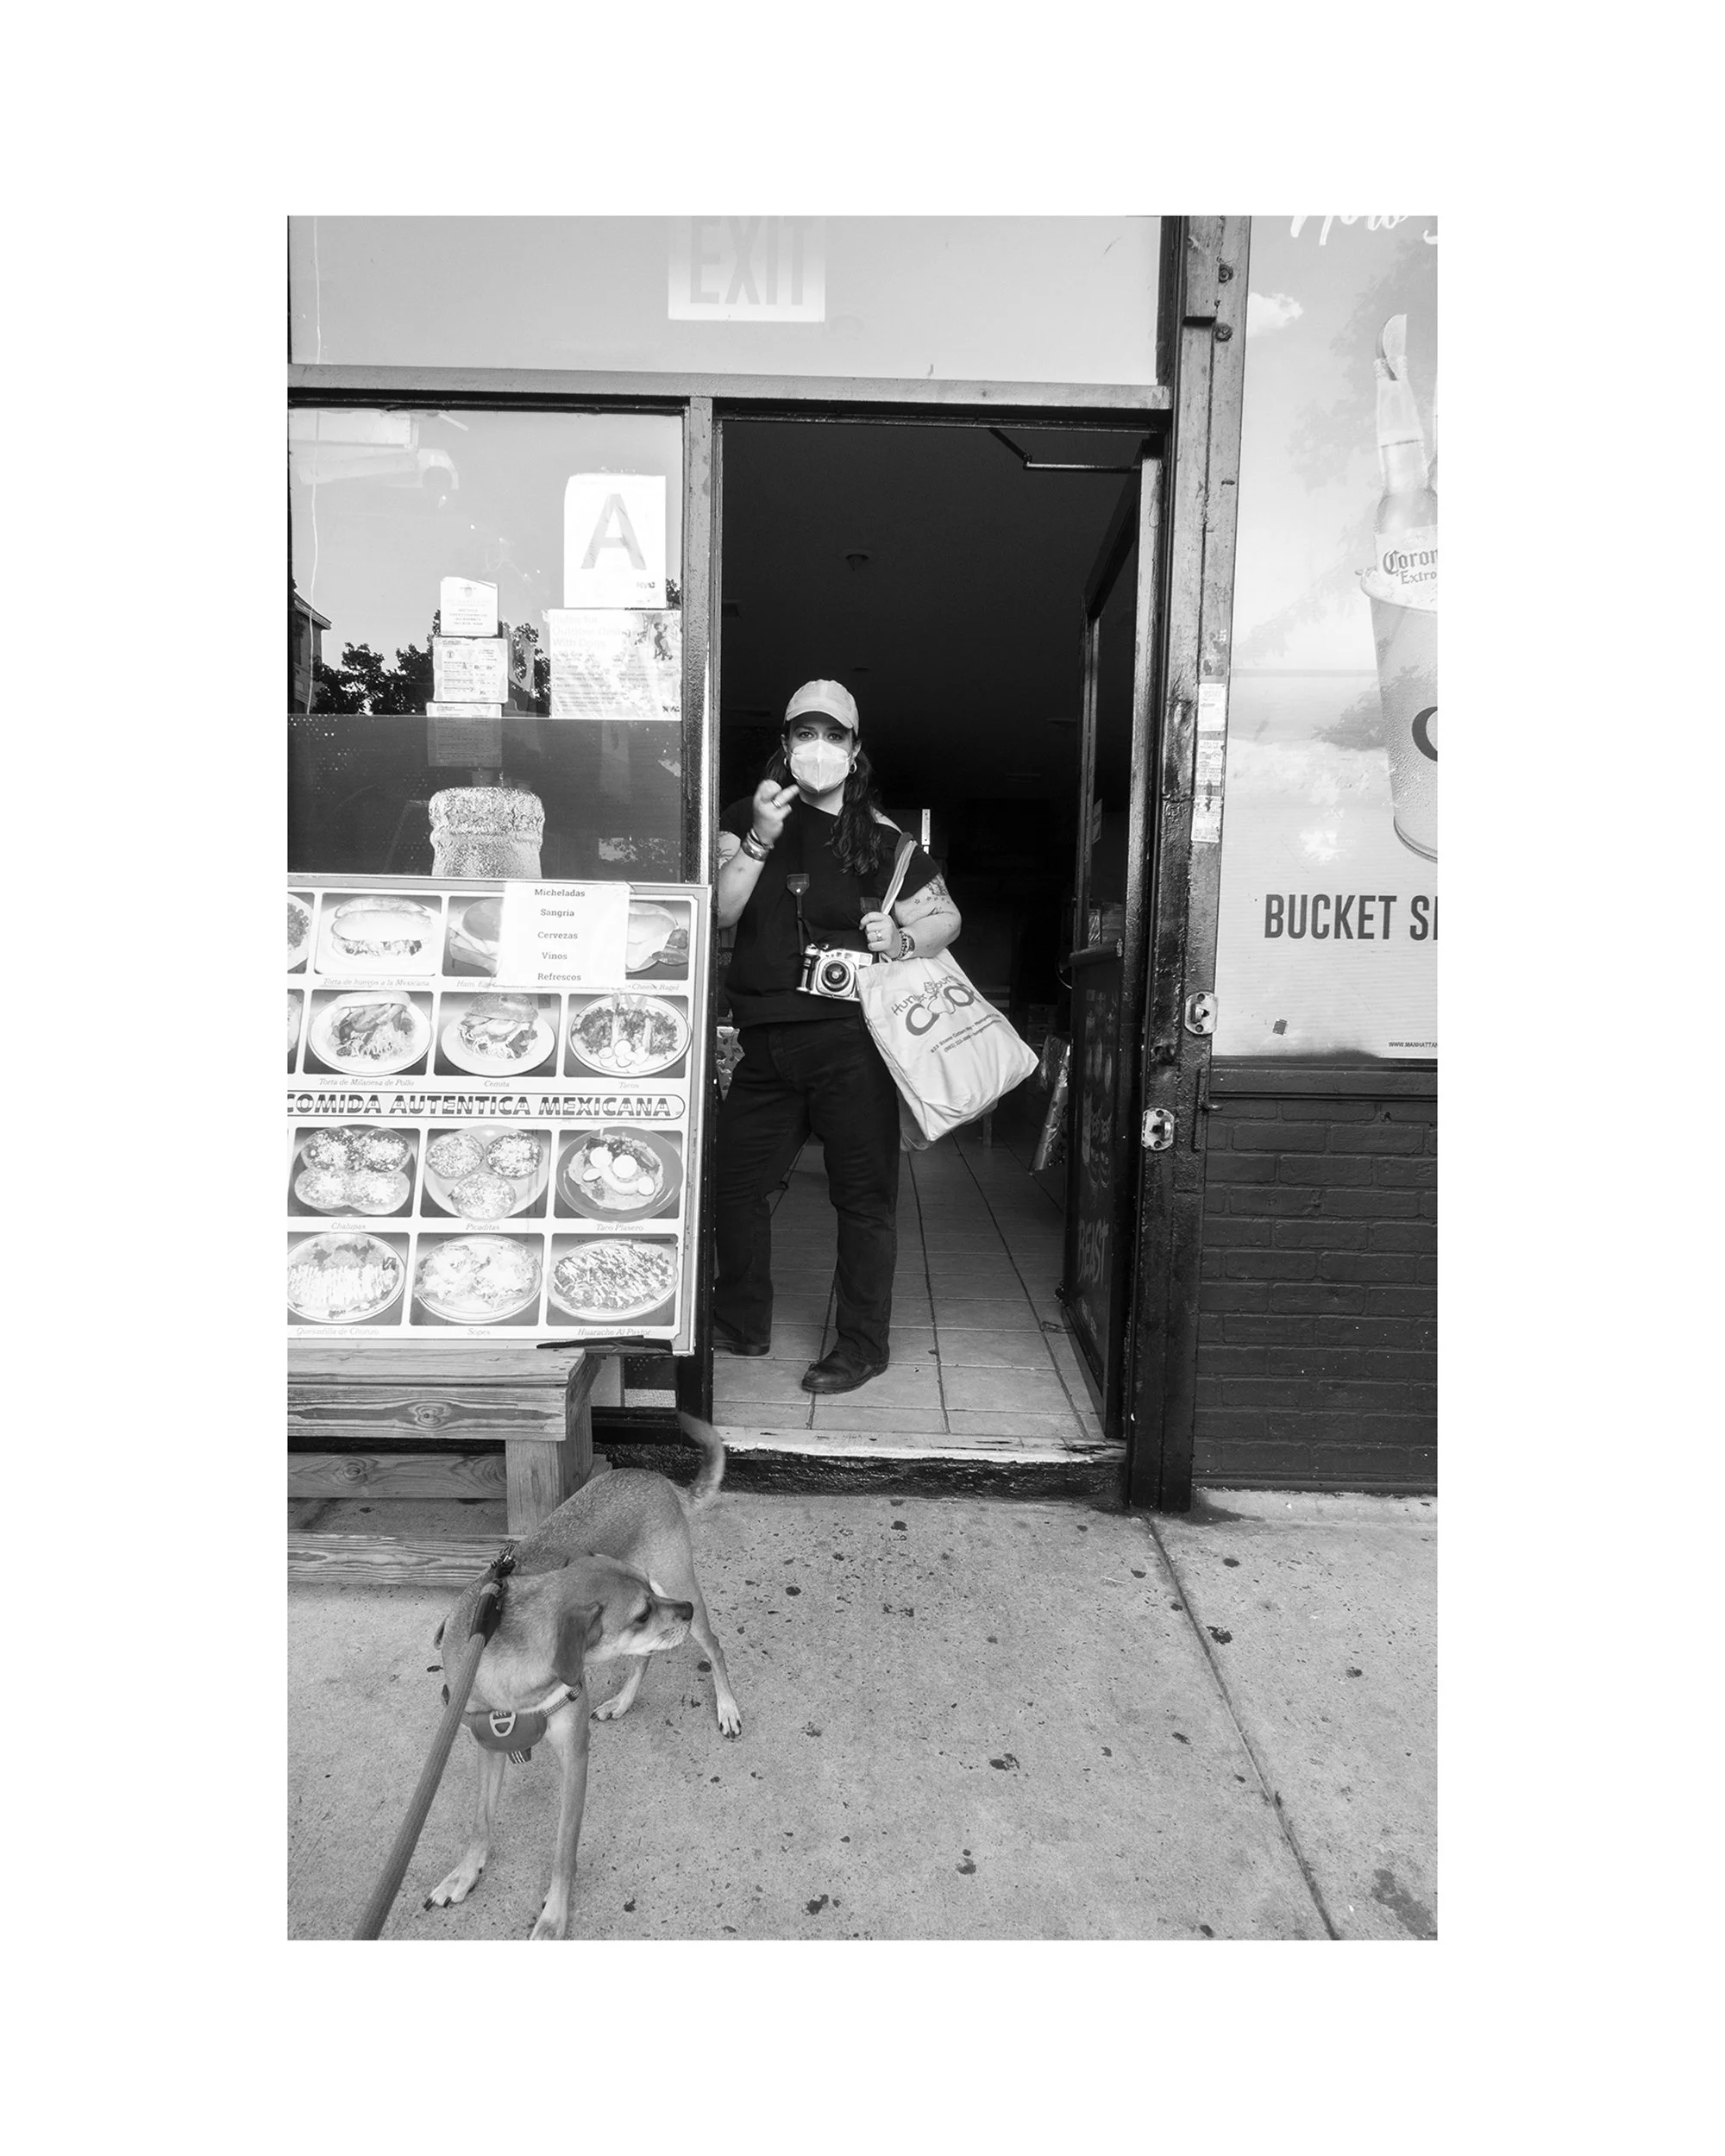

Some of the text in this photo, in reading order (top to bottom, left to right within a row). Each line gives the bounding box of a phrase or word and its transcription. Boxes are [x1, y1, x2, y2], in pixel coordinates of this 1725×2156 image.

[690, 216, 813, 306] EXIT
[580, 493, 647, 571] A
[534, 888, 586, 898] Micheladas
[540, 908, 575, 919] Sangria
[1264, 894, 1438, 941] BUCKET S
[537, 931, 579, 940] Cervezas
[542, 952, 568, 961] Vinos
[537, 972, 582, 981] Refrescos
[323, 977, 342, 986] Torta
[395, 979, 430, 987] Mexicana
[318, 1077, 337, 1086] Torta
[349, 1078, 382, 1087] Milanesa
[384, 1078, 393, 1087] de
[389, 1094, 531, 1116] AUTENTICA
[538, 1096, 671, 1117] MEXICANA
[331, 1221, 367, 1231] Chalupas
[466, 1222, 500, 1231] Picaditas
[596, 1223, 613, 1232] Taco
[296, 1326, 337, 1337] Quesadilla
[338, 1327, 348, 1336] de
[467, 1327, 490, 1338] Sopes
